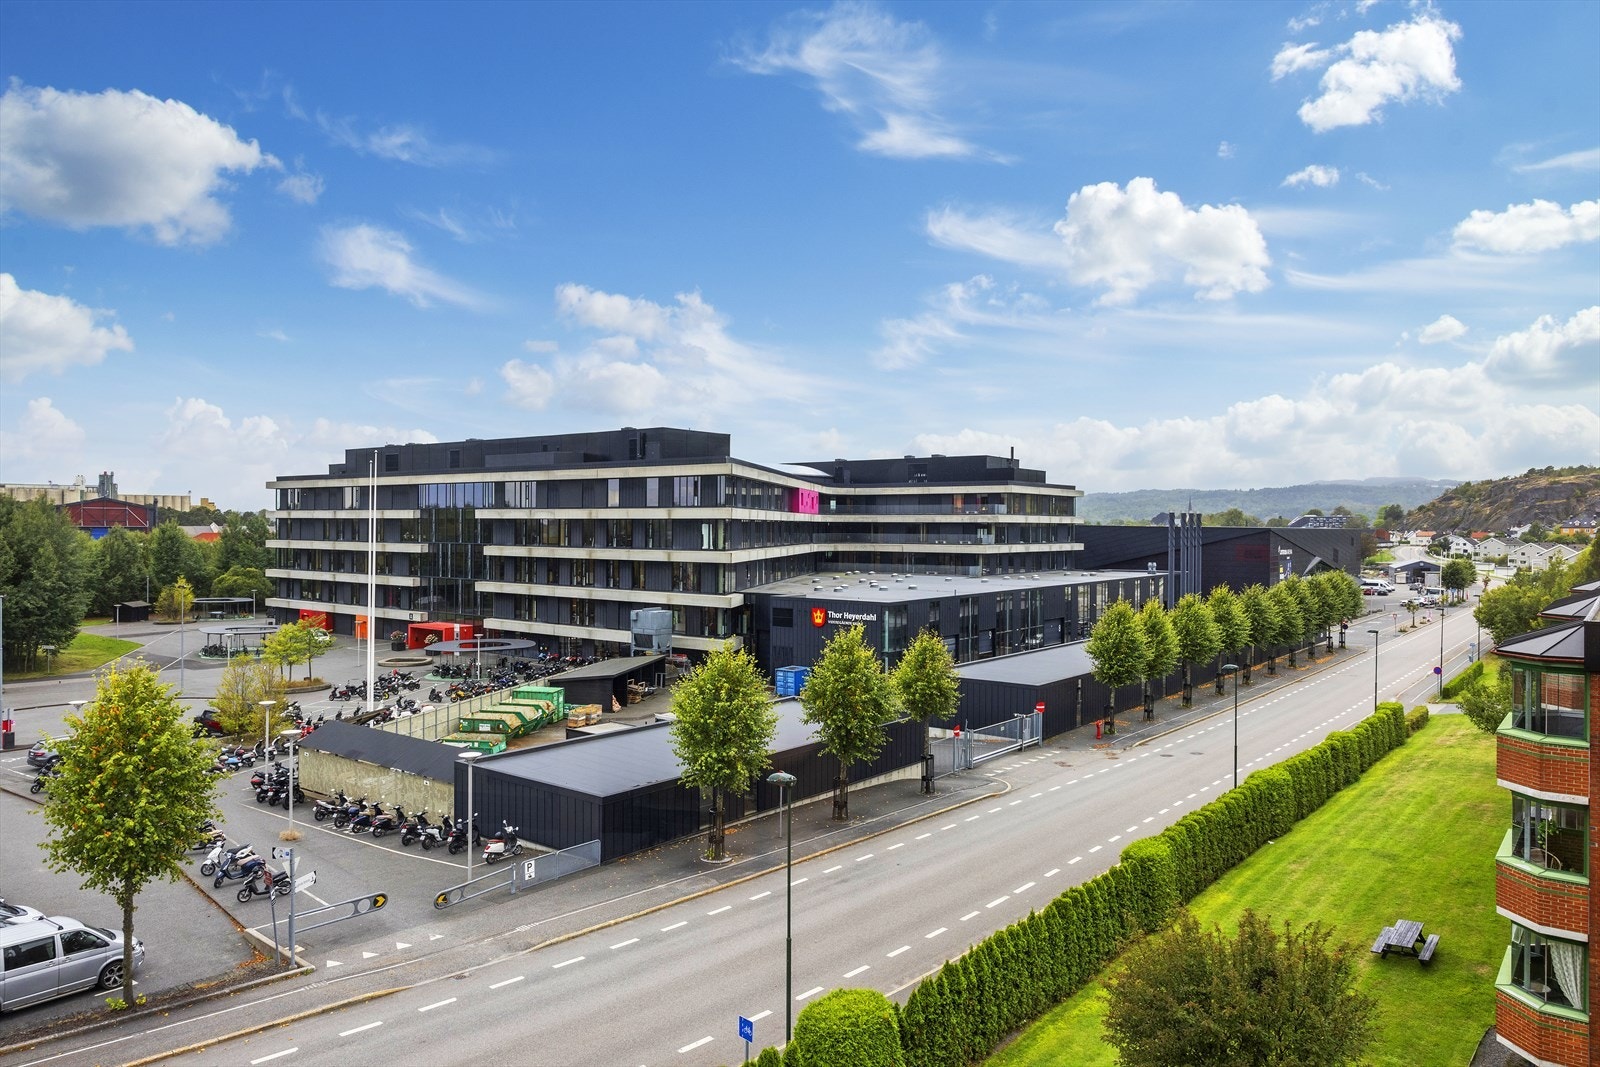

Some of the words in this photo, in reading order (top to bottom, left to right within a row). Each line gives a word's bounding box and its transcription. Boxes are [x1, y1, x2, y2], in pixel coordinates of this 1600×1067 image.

[828, 611, 842, 619] Thor
[843, 612, 877, 621] Heyerdahl
[527, 863, 532, 872] P
